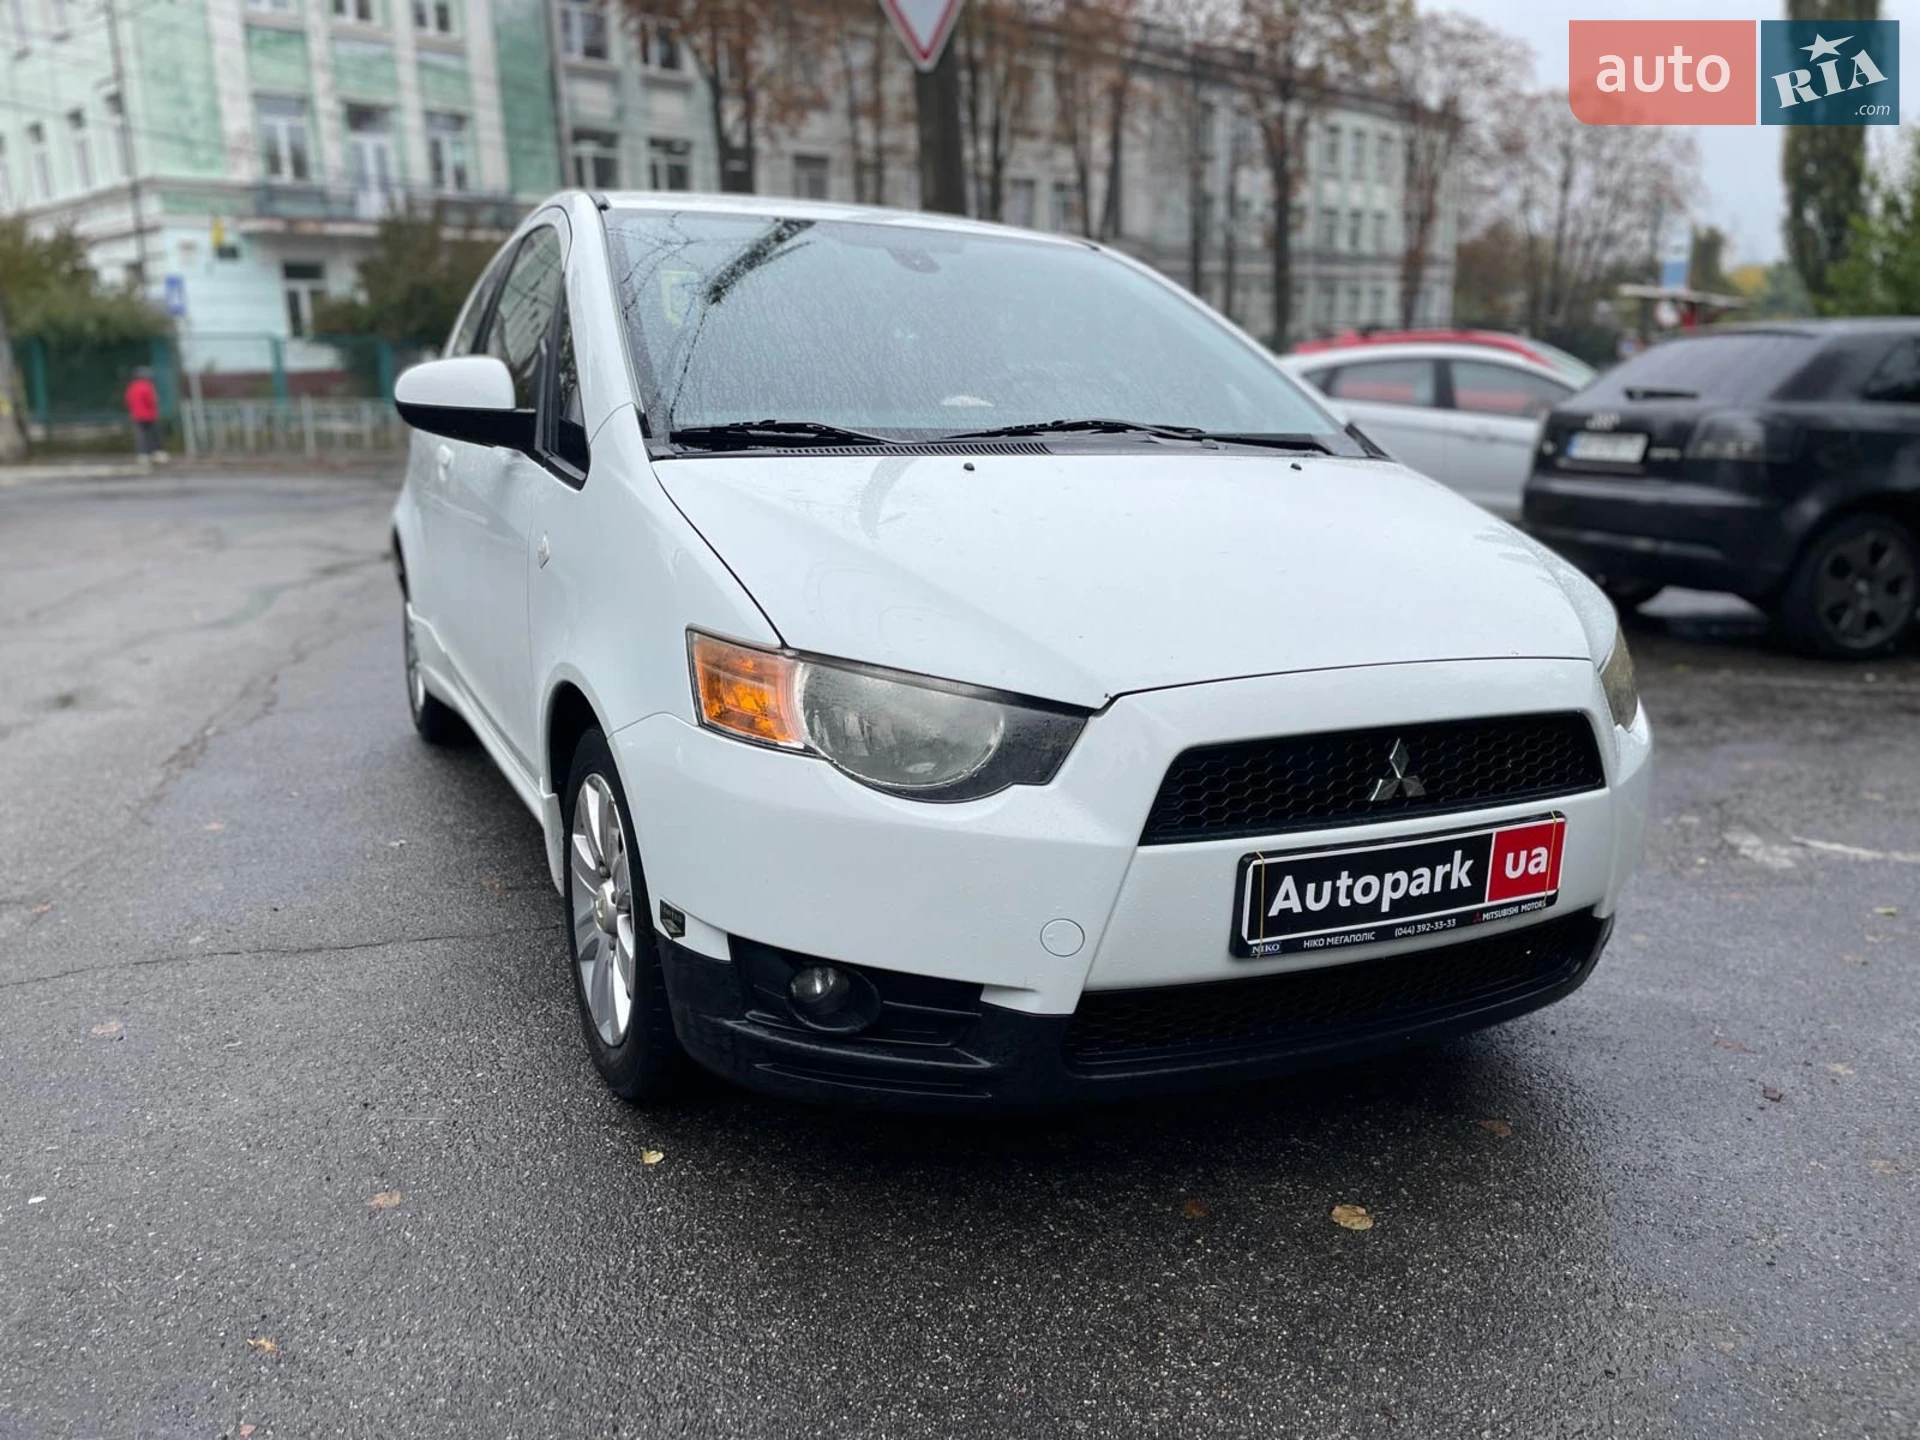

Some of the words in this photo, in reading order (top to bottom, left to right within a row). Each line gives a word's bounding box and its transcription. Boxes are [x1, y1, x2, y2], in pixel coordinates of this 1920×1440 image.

[1268, 849, 1474, 917] Autopark
[1504, 846, 1549, 880] ua
[1482, 905, 1519, 921] MITSUBISHI
[1521, 900, 1547, 912] MOTORS
[1394, 926, 1415, 938] (044)
[1416, 919, 1457, 933] 392-33-33
[1326, 931, 1376, 946] МЕГАПОЛІС
[1252, 943, 1280, 954] NIKO
